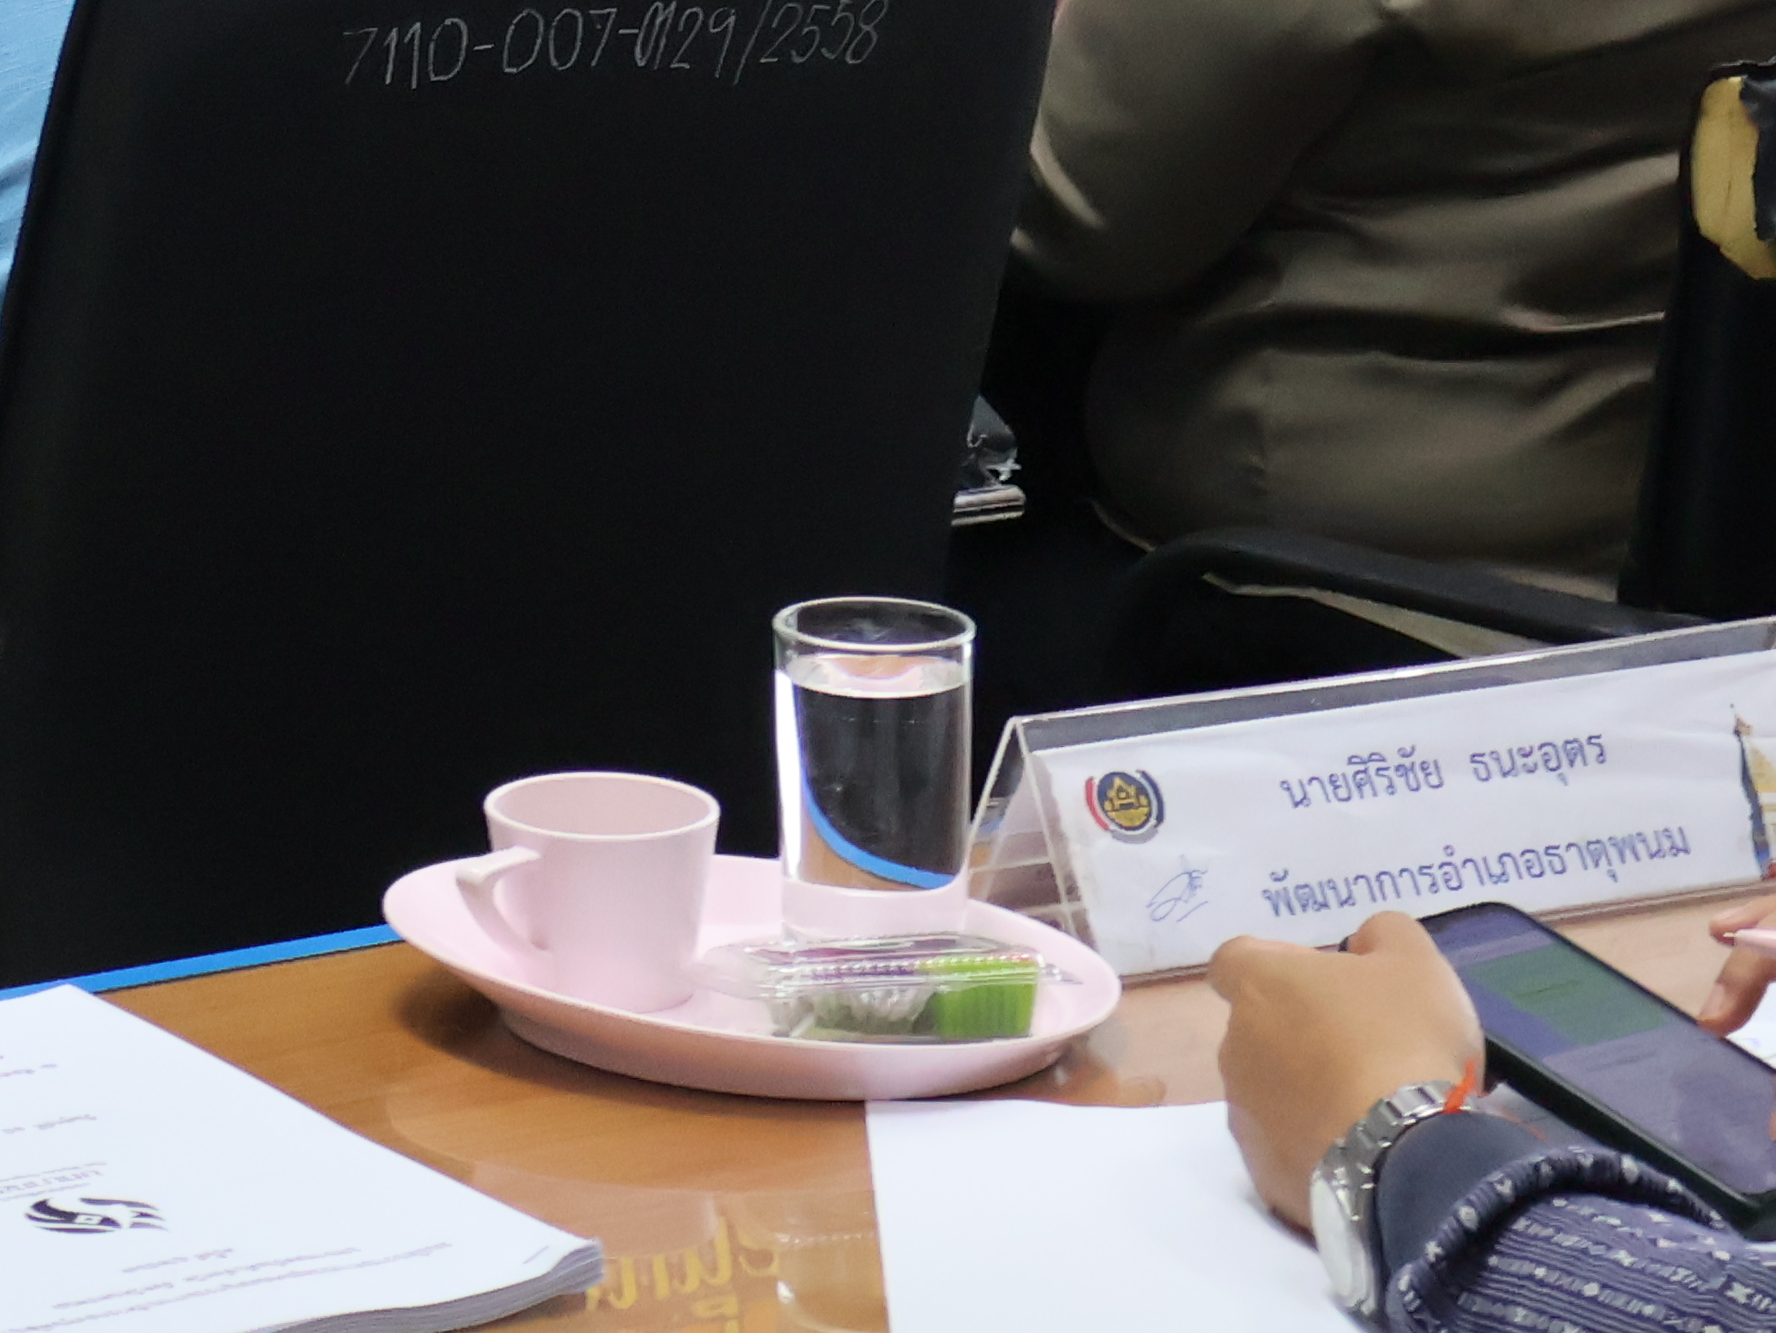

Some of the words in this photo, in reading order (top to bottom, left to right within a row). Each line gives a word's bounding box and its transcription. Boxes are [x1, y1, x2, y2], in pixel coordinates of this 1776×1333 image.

[1280, 745, 1445, 810] นายศิริชัย
[1469, 733, 1608, 786] ธนะอุตร
[1262, 825, 1691, 920] พัฒนาการอำเภอธาตุพนม
